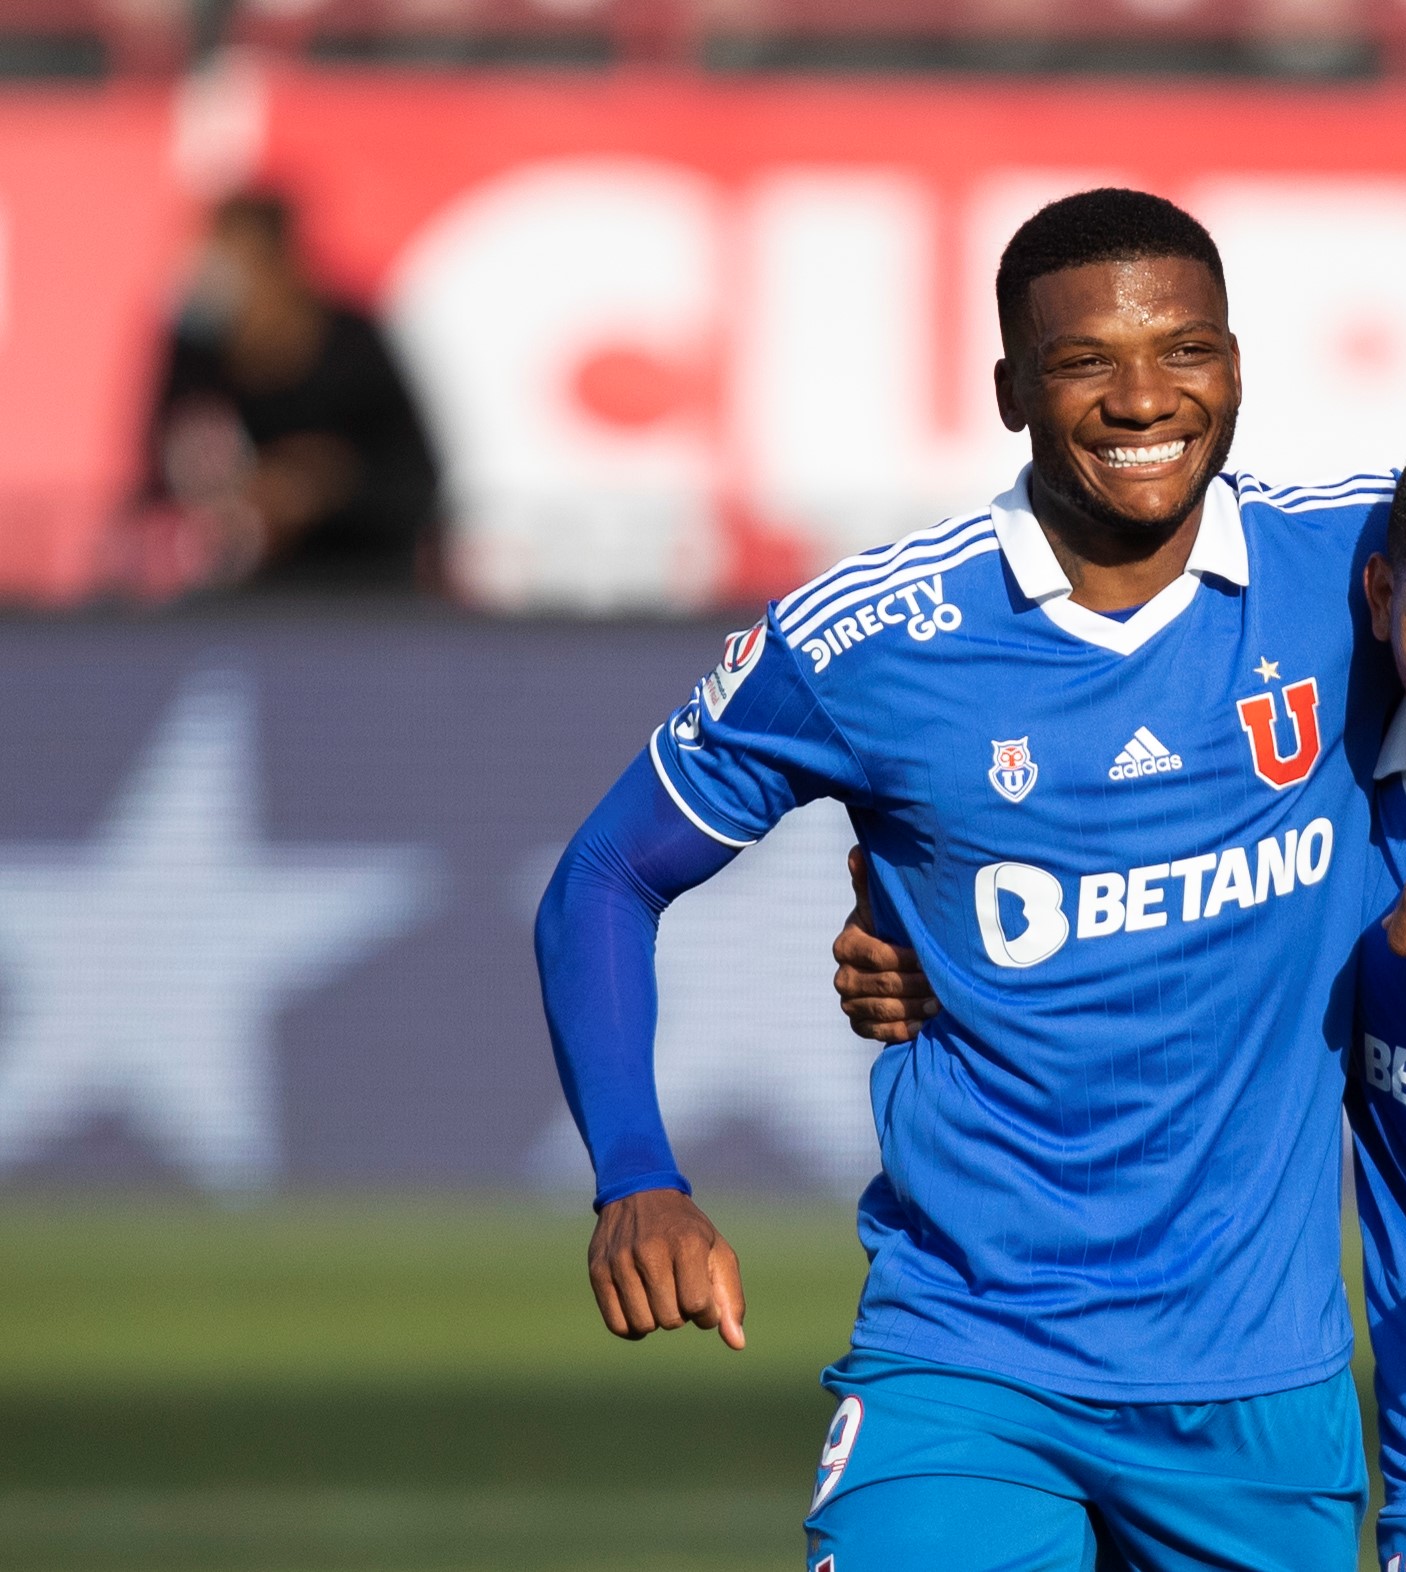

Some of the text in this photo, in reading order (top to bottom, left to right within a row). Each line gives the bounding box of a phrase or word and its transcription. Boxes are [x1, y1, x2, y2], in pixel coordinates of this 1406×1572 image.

[801, 574, 944, 673] DIRECTV
[907, 603, 962, 641] GO
[1108, 753, 1183, 781] adidas
[1236, 677, 1322, 791] U
[1076, 816, 1334, 939] BETANO
[809, 1394, 864, 1516] 9
